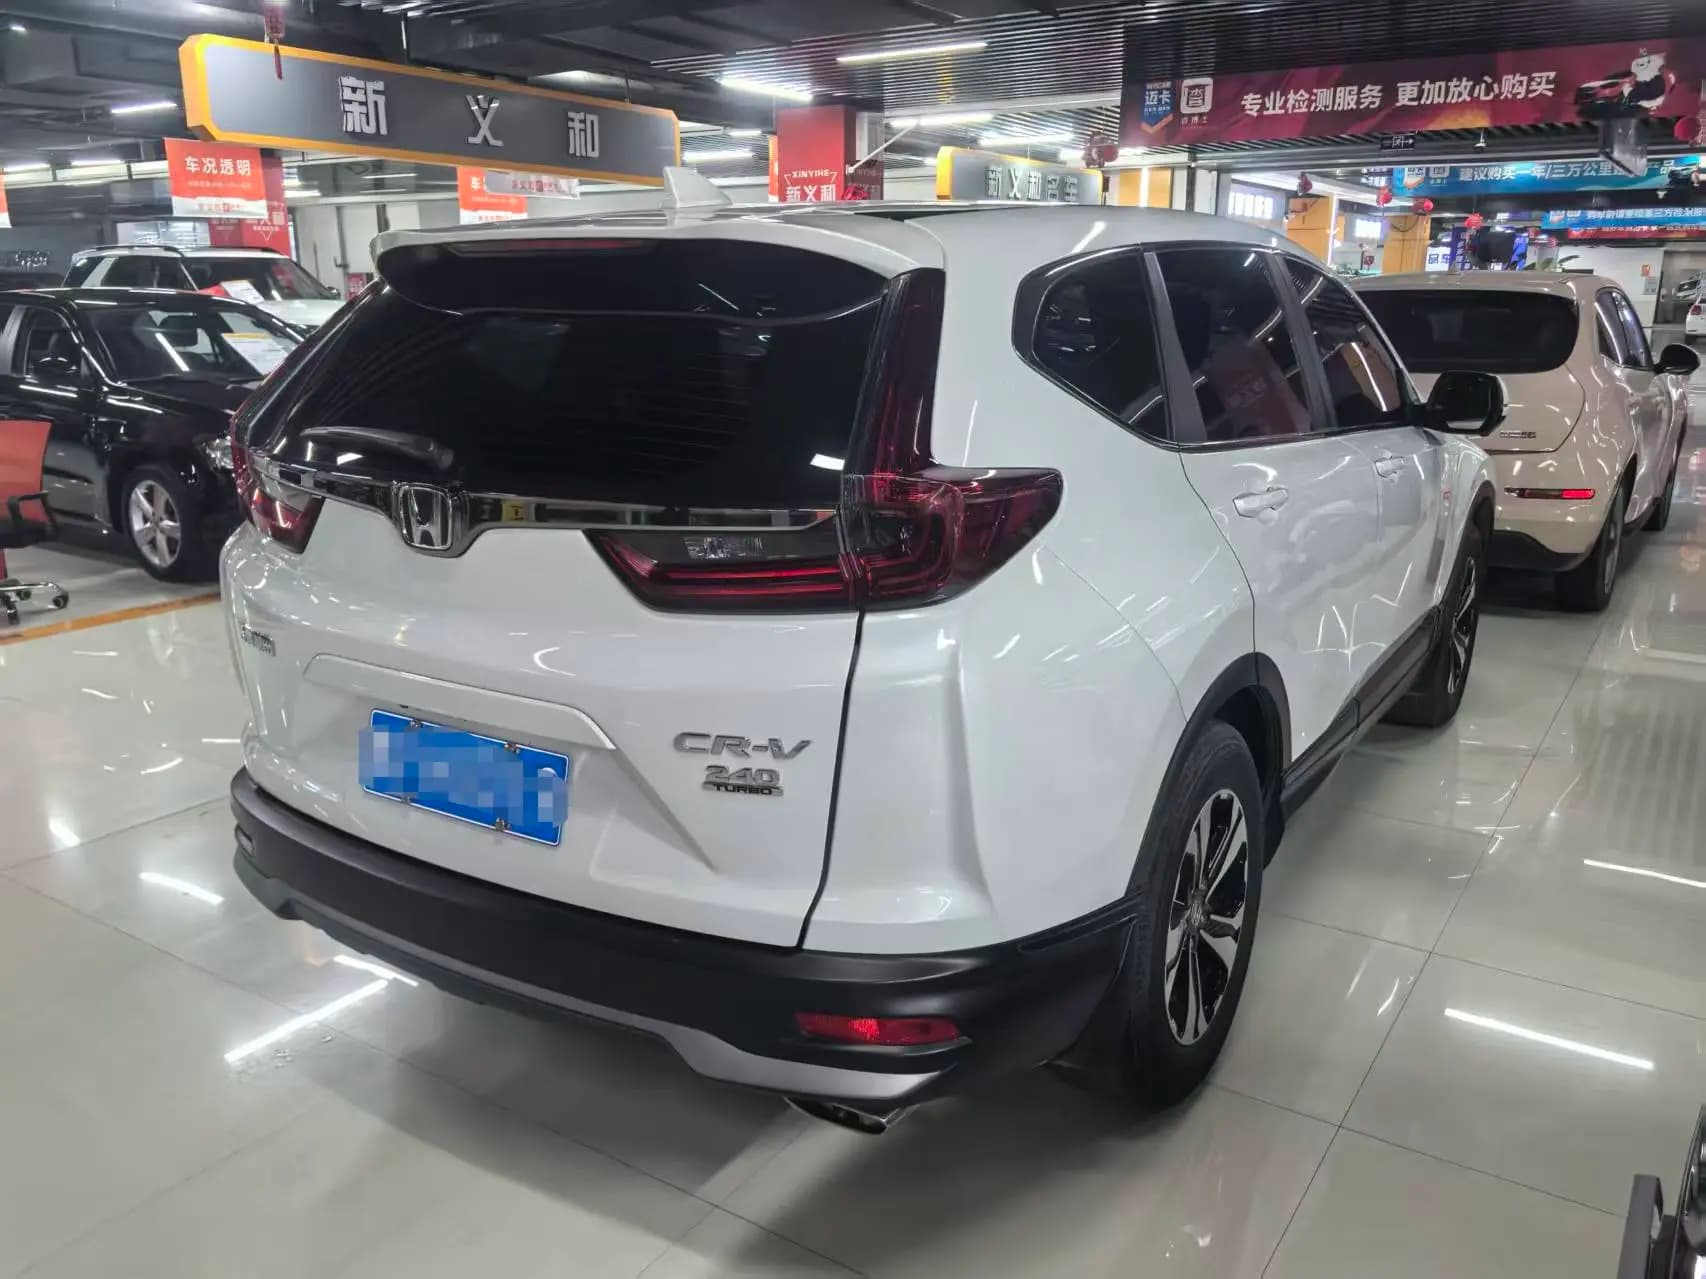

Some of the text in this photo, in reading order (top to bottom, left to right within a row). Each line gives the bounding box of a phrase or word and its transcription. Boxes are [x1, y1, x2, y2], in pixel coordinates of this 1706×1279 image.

[1145, 90, 1171, 105] 迈卡
[1241, 71, 1556, 117] 专业检测服务 更加放心购买
[185, 156, 251, 176] 车况透明
[792, 169, 830, 178] XINYIHE
[786, 184, 836, 201] 新义和
[673, 732, 812, 760] CR-V
[705, 765, 780, 786] 240
[713, 783, 774, 796] TURBO
